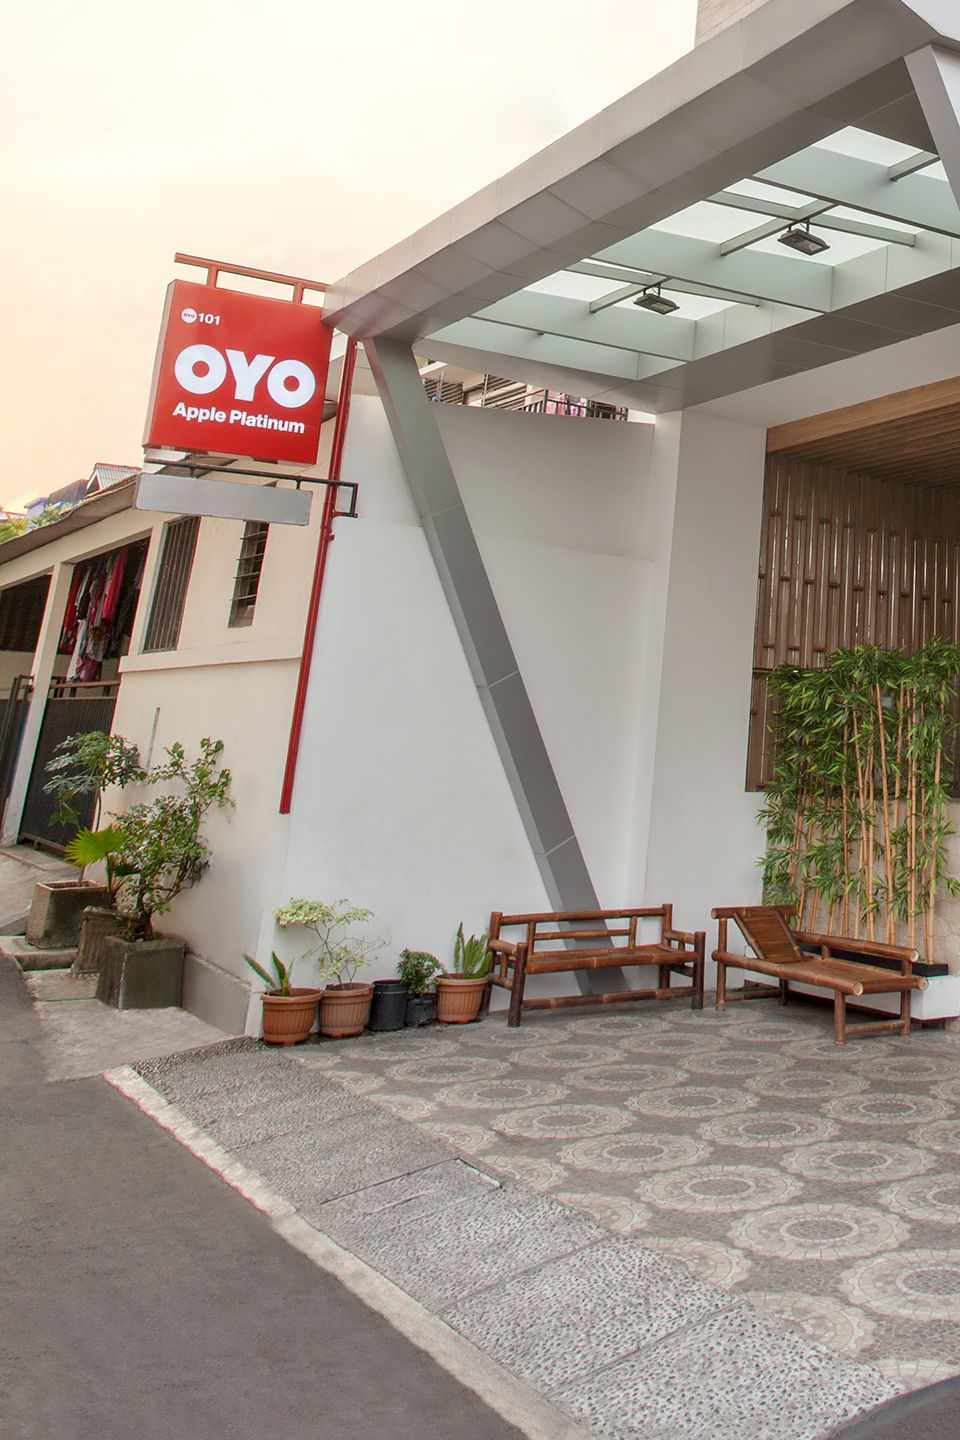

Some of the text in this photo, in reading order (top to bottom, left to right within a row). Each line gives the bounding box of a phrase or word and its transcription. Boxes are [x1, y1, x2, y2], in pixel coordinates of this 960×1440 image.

[198, 312, 220, 326] 101
[174, 344, 316, 408] OYO
[172, 402, 305, 434] Apple Platinum
